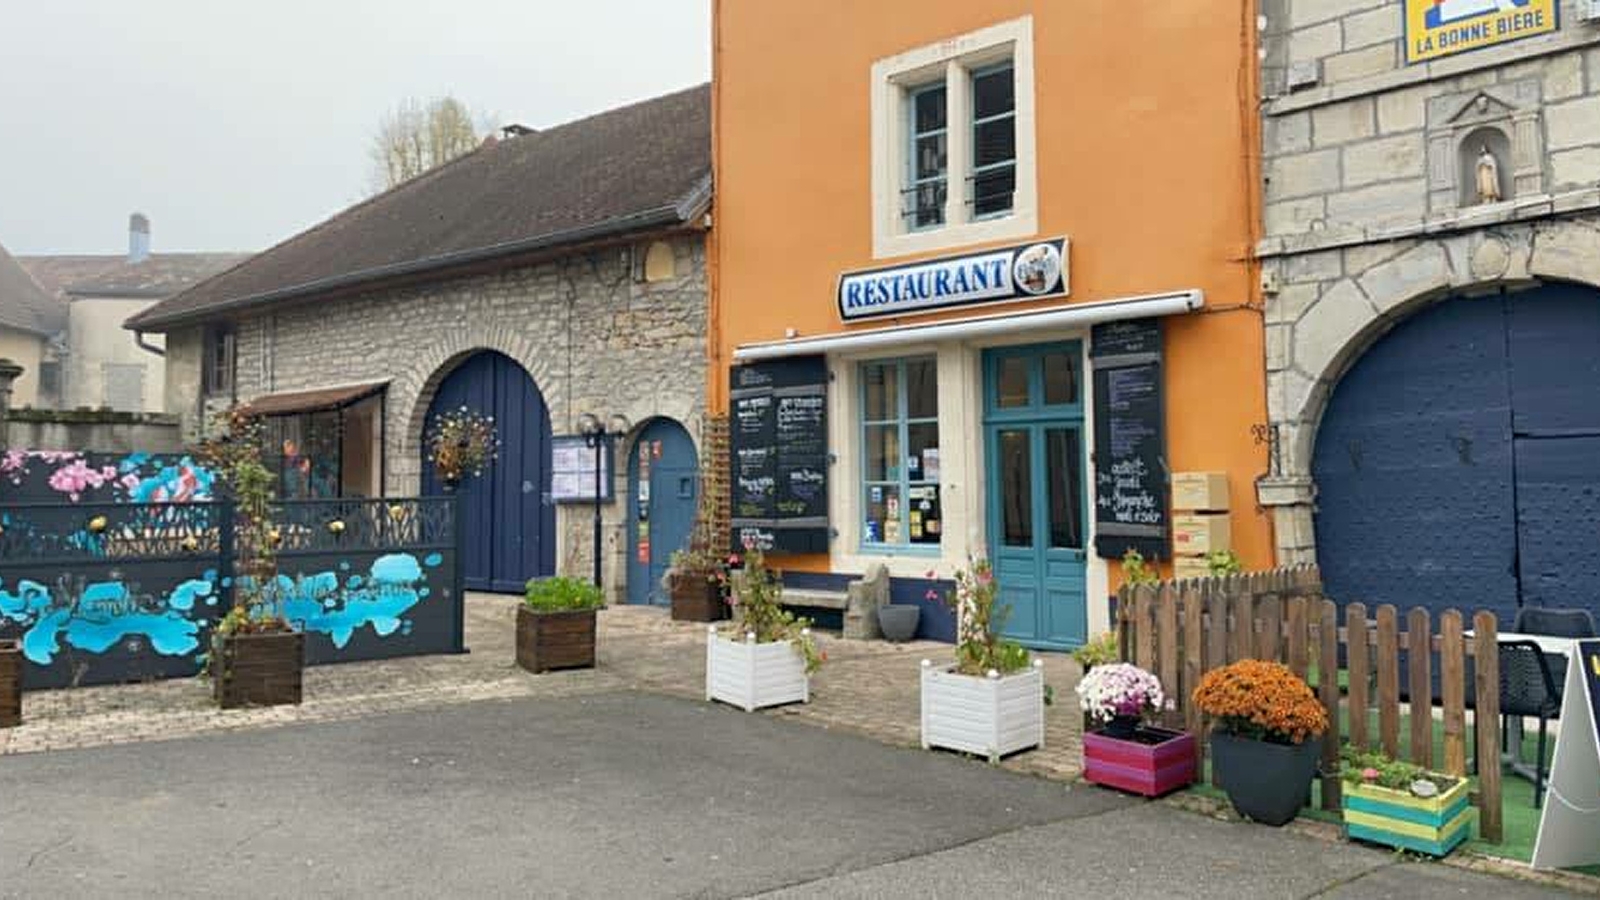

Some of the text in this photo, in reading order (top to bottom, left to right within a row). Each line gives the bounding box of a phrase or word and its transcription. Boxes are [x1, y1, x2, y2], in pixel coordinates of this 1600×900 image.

[1417, 38, 1434, 54] LA
[1439, 22, 1491, 48] BONNE
[847, 259, 1007, 309] RESTAURANT
